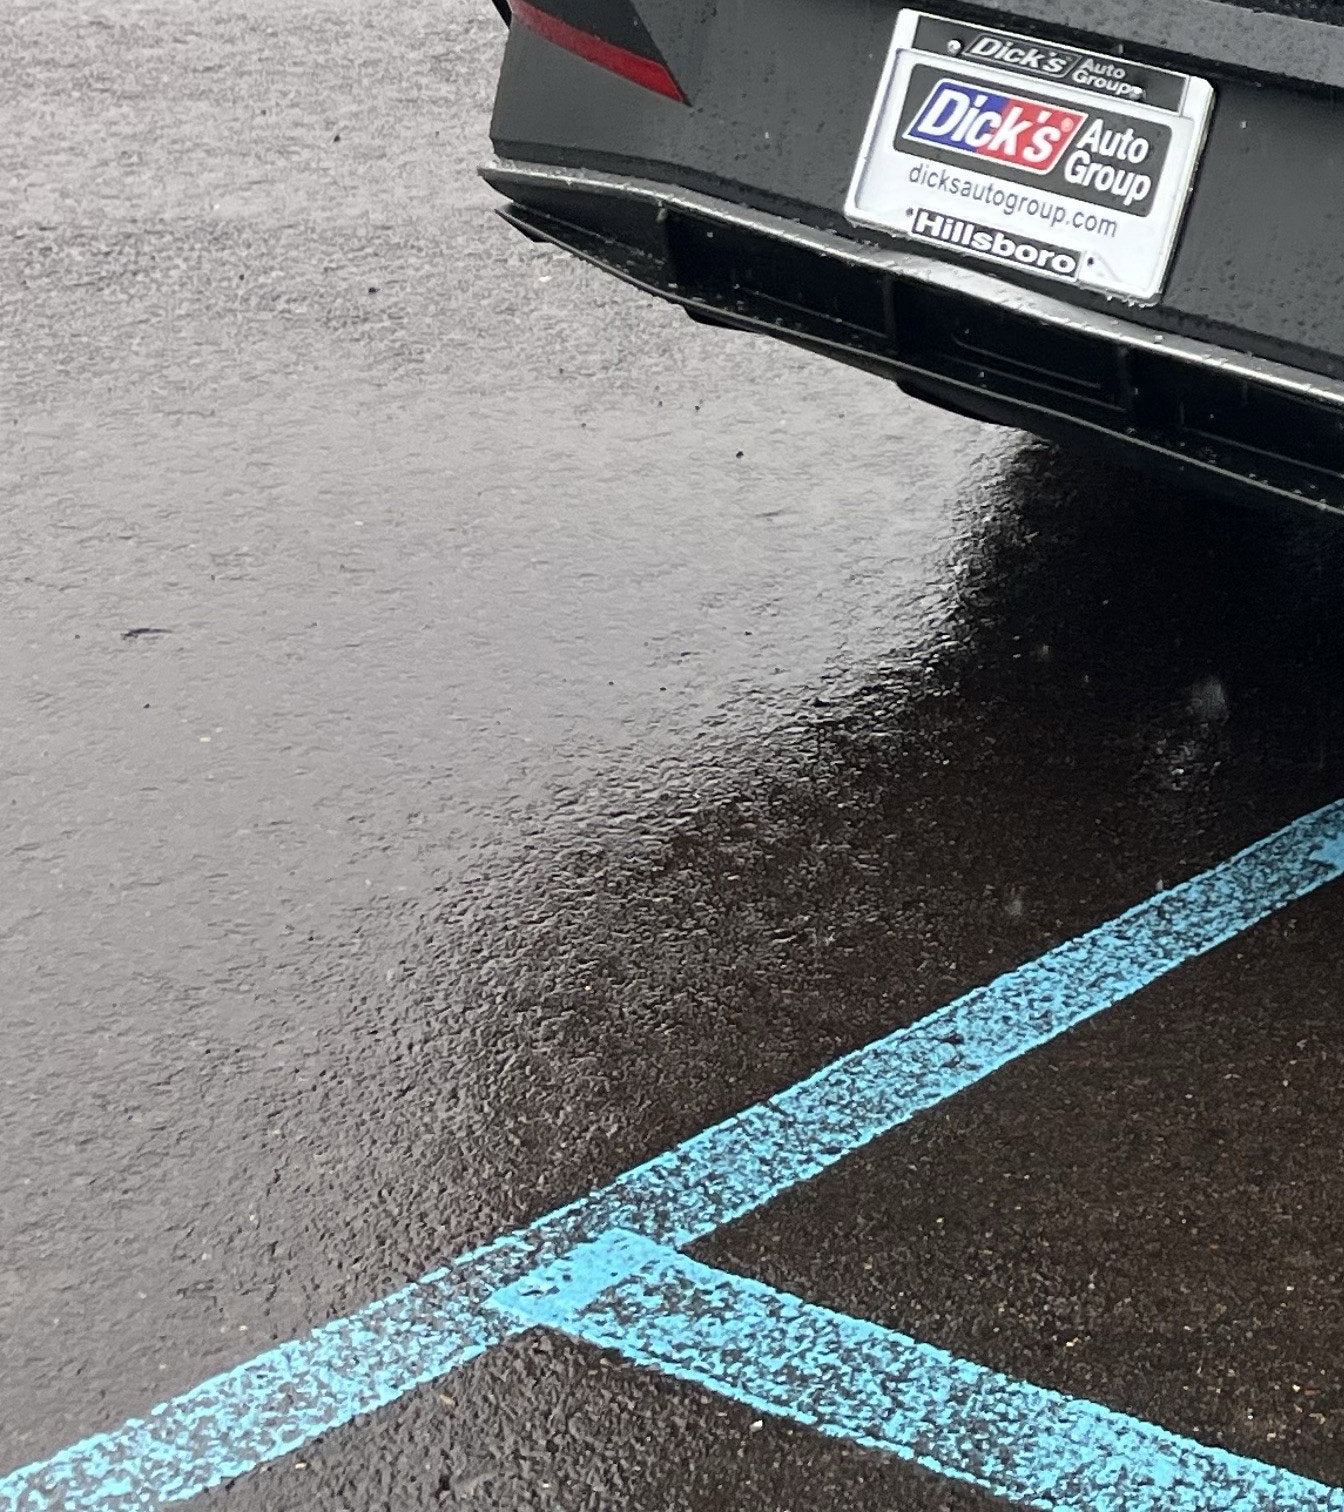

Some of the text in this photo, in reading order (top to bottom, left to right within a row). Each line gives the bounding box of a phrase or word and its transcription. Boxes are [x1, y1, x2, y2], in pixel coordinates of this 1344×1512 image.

[970, 36, 1067, 74] Dick's
[1078, 57, 1128, 81] Auto
[1071, 69, 1140, 96] Group
[917, 88, 1061, 164] Dick's
[1076, 118, 1149, 164] Auto
[908, 162, 1118, 238] dicksautogroup.com
[1064, 150, 1152, 206] Group
[913, 209, 1077, 275] Hillsboro
